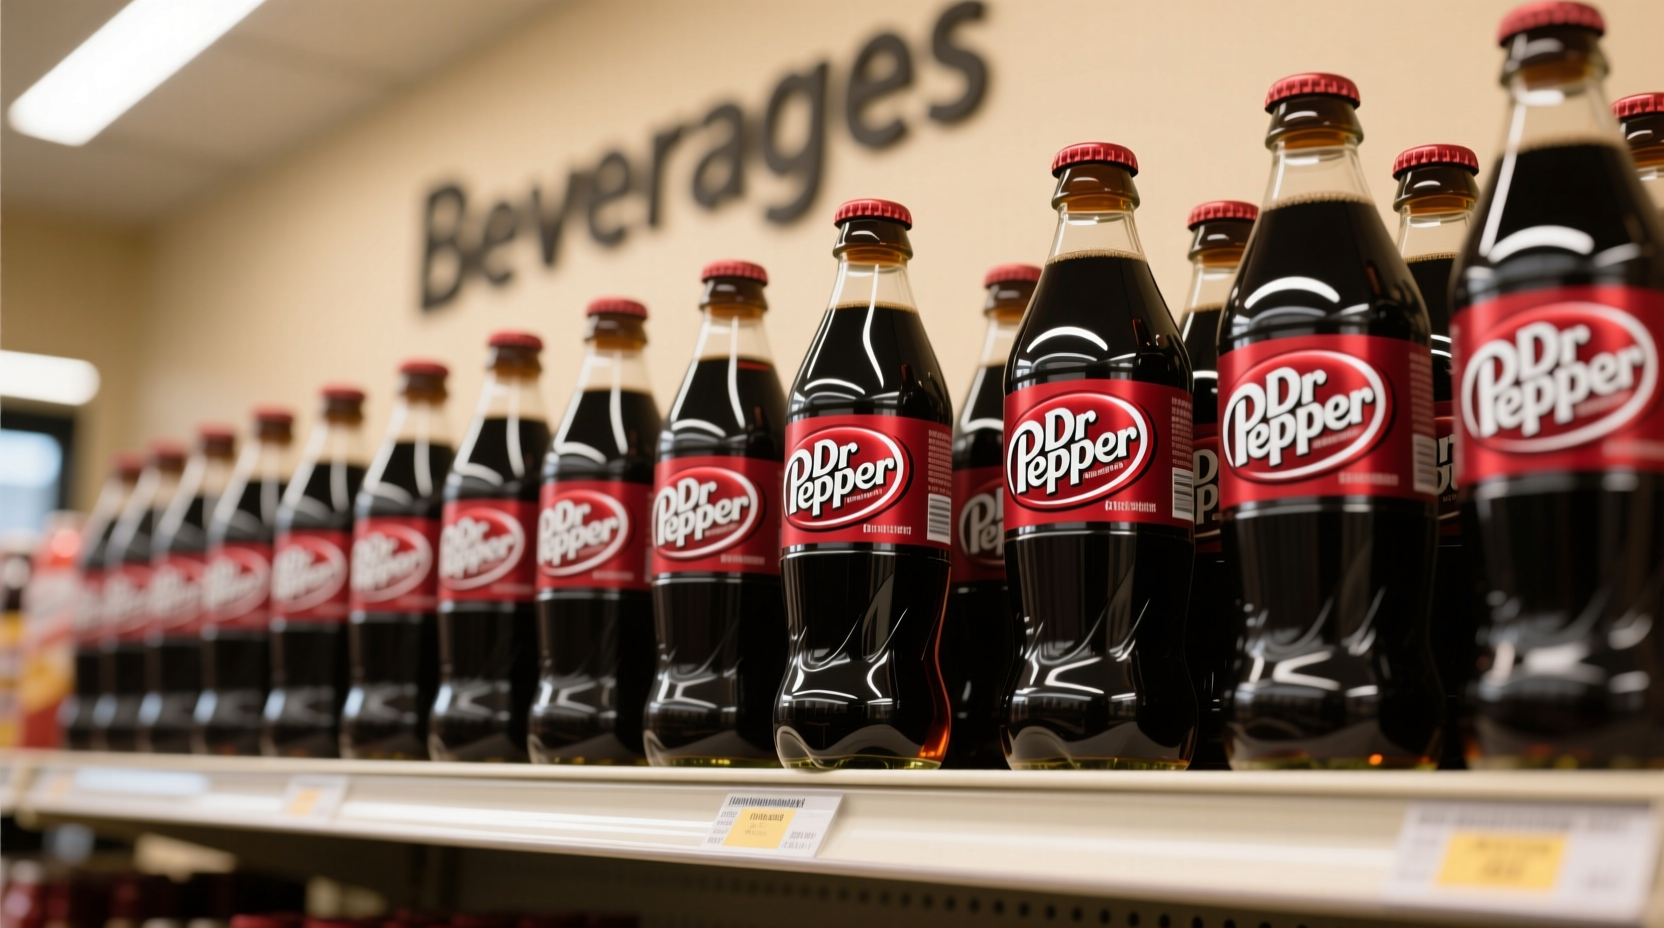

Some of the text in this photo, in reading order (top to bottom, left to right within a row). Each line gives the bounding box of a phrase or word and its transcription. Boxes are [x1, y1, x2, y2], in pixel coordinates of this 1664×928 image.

[419, 1, 991, 313] Beverages
[1515, 320, 1591, 381] Dr
[1265, 366, 1328, 419] Dr
[1461, 338, 1645, 439] Pepper
[1044, 407, 1097, 452] Dr
[1223, 382, 1375, 468] Pepper
[785, 448, 896, 517] Pepper
[812, 438, 859, 478] Dr
[1007, 419, 1138, 495] Pepper
[554, 499, 592, 533] Dr
[654, 486, 750, 548] Pepper
[677, 477, 718, 514] Dr
